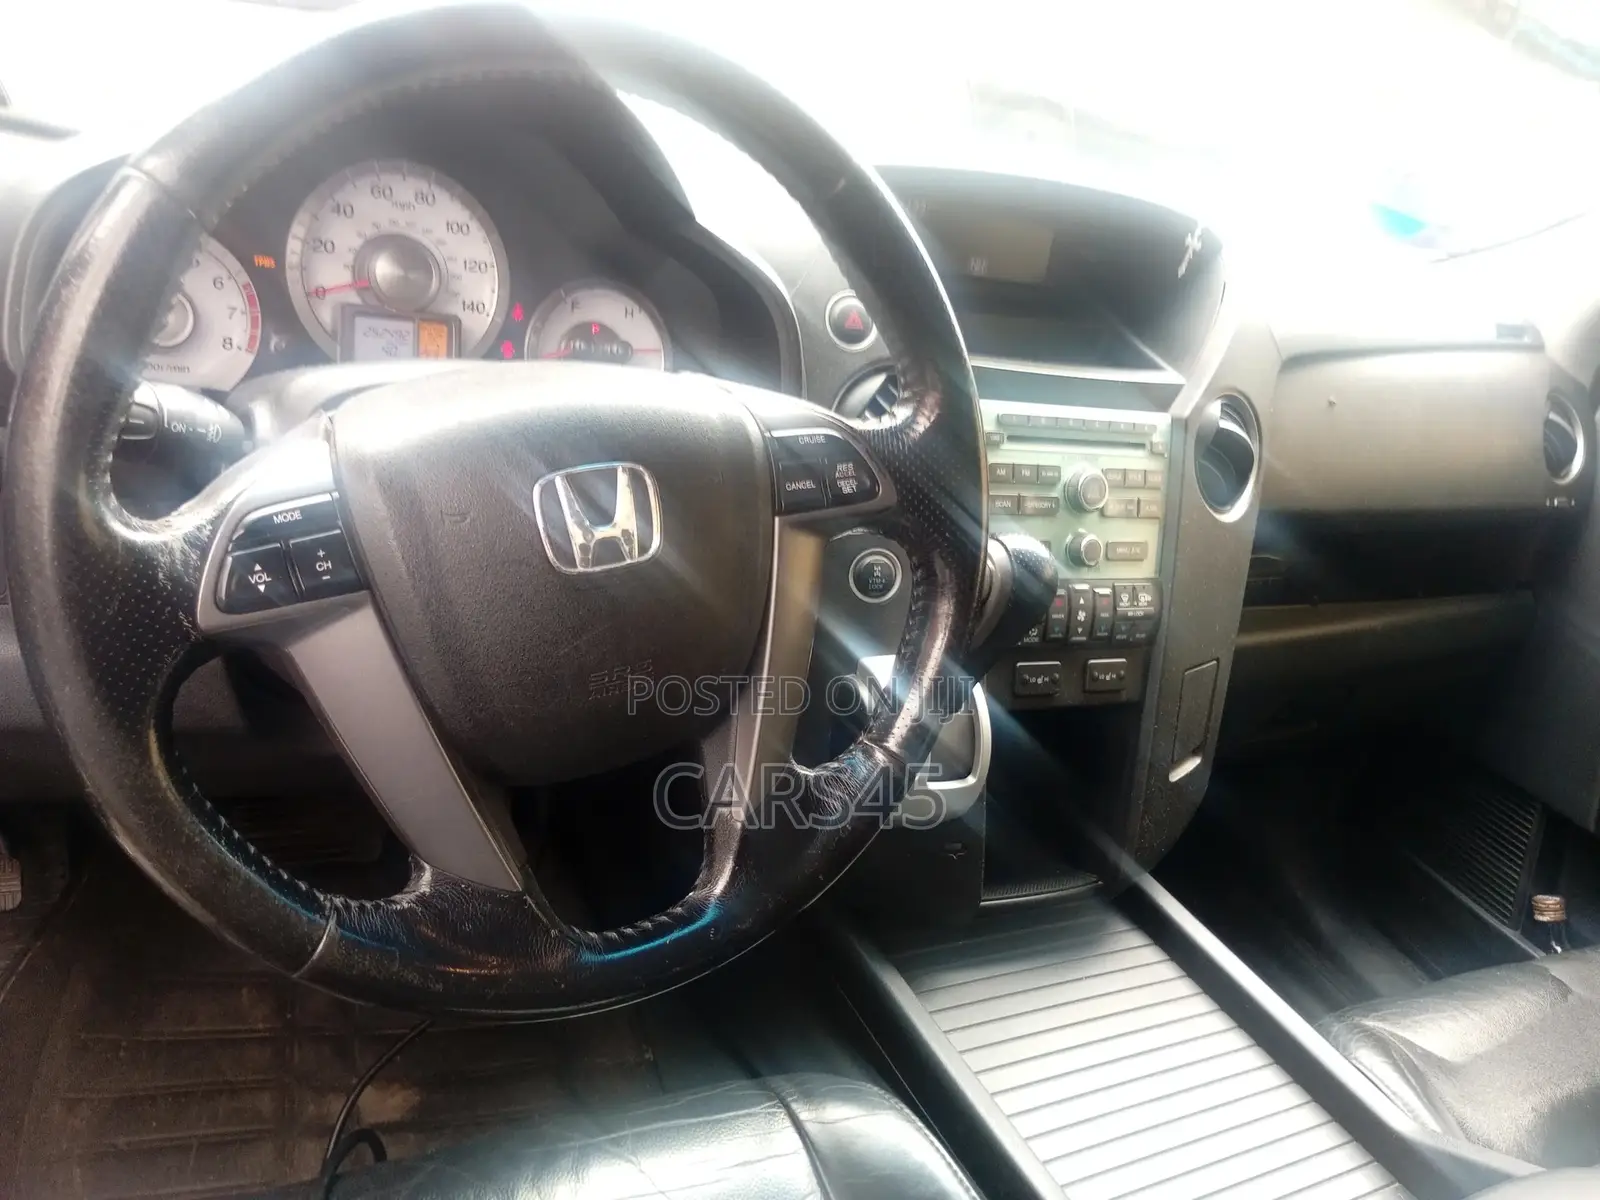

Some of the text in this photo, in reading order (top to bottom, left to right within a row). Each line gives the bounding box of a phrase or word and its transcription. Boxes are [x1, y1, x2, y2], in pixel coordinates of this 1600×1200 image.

[370, 184, 394, 201] 60
[414, 189, 437, 207] 80
[331, 201, 355, 219] 40
[445, 220, 471, 237] 100
[312, 238, 336, 254] 20
[462, 259, 488, 275] 120
[212, 276, 225, 291] 6
[226, 305, 238, 320] 7
[461, 299, 487, 316] 140
[624, 306, 634, 319] H
[221, 336, 233, 351] 8
[171, 422, 187, 434] ON
[798, 434, 826, 445] CRUISE
[835, 470, 857, 478] ACCEL
[836, 463, 853, 472] RES
[996, 467, 1006, 476] AM
[785, 479, 816, 492] CANCEL
[837, 479, 858, 487] DECEL
[842, 486, 857, 494] SET
[272, 510, 302, 525] MODE
[315, 560, 332, 572] CH
[248, 571, 272, 584] VOL
